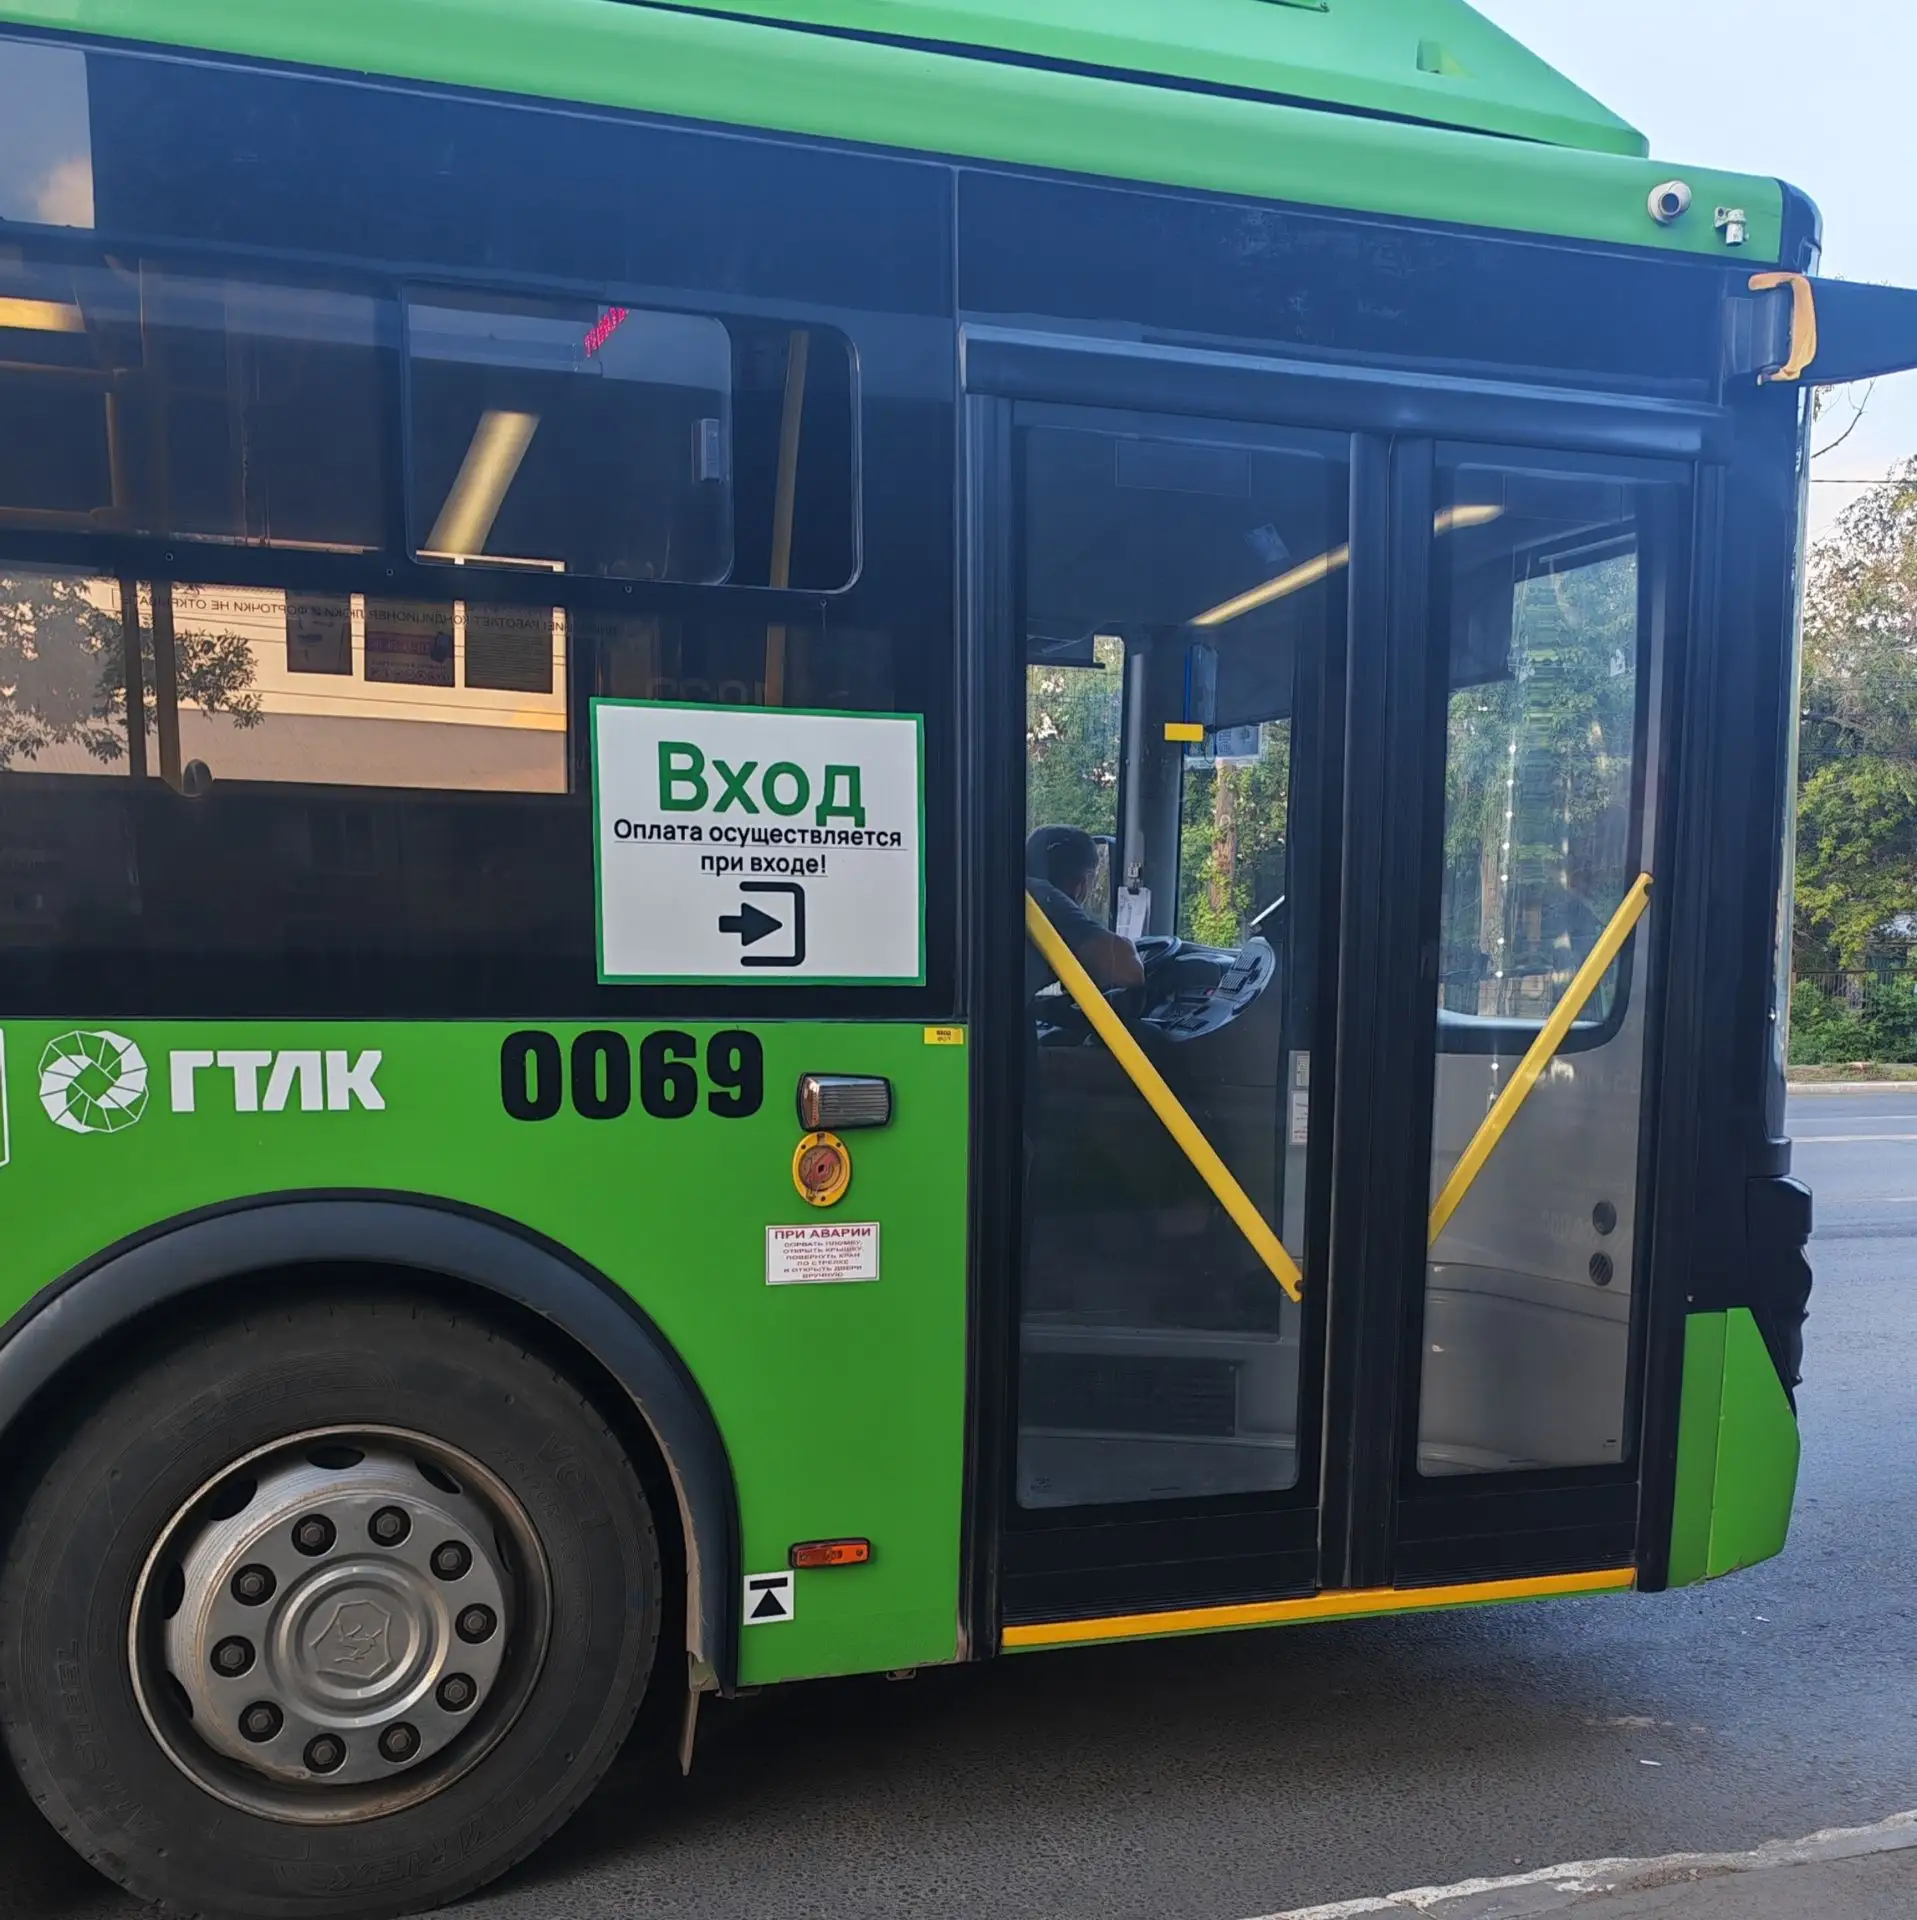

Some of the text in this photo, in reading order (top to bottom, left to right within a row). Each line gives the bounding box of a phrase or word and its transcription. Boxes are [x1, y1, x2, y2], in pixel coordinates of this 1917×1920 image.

[658, 741, 865, 827] Вход
[614, 818, 901, 848] Оплата осуществляется
[700, 854, 827, 877] при входе!
[169, 1050, 386, 1112] ГТЛК
[499, 1029, 764, 1121] 0069
[775, 1228, 871, 1240] ПРИ АВАРИИ
[56, 1639, 108, 1770] STEEL
